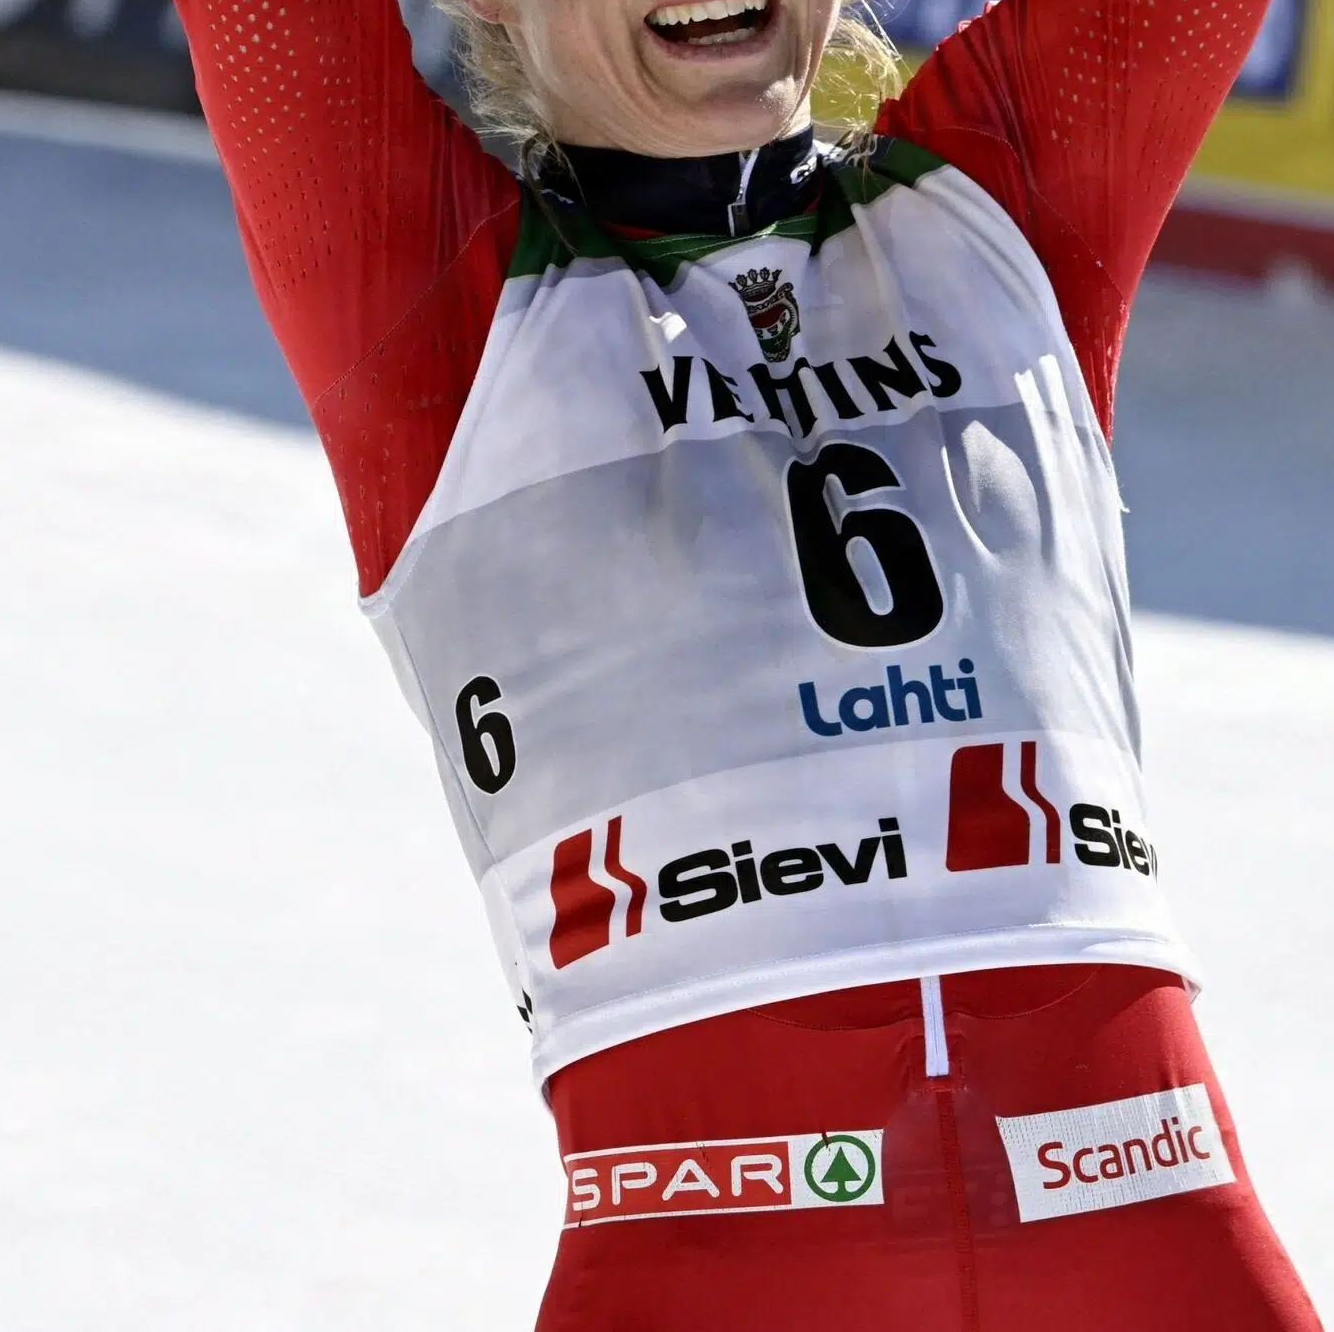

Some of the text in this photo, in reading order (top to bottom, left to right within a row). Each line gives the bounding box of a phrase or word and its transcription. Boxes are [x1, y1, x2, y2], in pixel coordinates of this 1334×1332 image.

[785, 441, 945, 648] 6
[455, 675, 516, 795] 6
[799, 658, 984, 737] Lahti
[659, 817, 908, 923] Sievi
[571, 1150, 785, 1211] SPAR
[1037, 1117, 1211, 1191] Scandic
